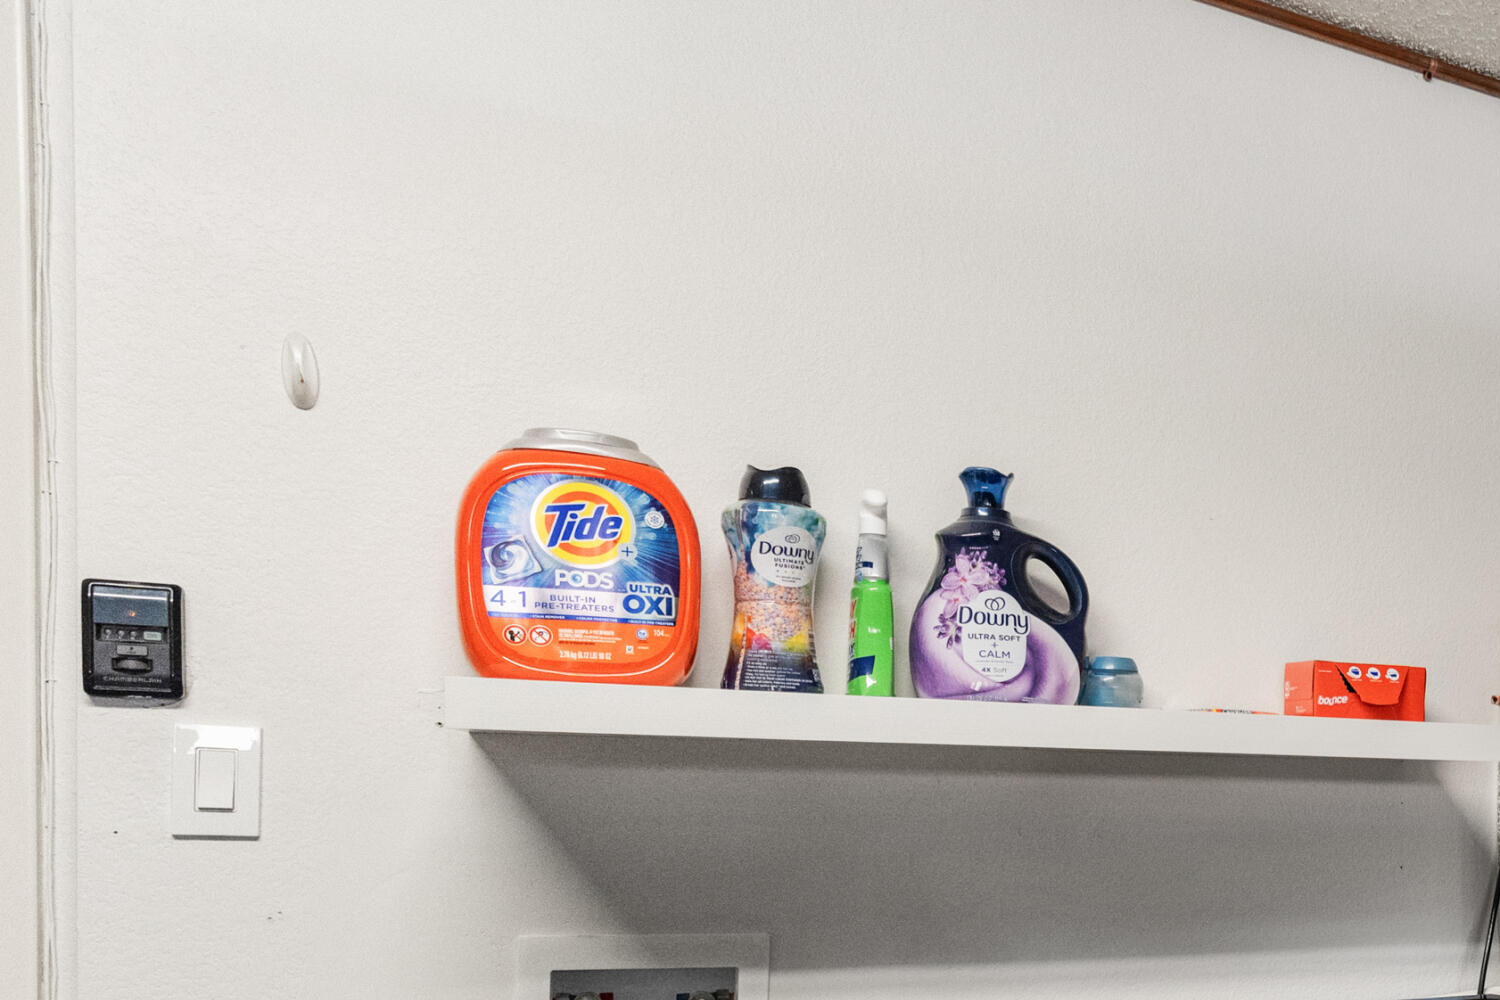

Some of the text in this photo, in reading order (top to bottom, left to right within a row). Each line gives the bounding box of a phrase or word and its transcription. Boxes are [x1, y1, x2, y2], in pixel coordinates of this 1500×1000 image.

[543, 503, 623, 548] Tide
[758, 540, 815, 565] Downy
[774, 557, 805, 566] ULTIMATE
[555, 569, 614, 590] PODS
[629, 583, 672, 596] ULTRA
[549, 594, 597, 604] BUILT-IN
[622, 593, 673, 617] OXI
[534, 601, 615, 613] PRE-TREATERS
[958, 605, 1029, 635] Downy
[967, 632, 1021, 642] ULTRA SOFT
[978, 649, 1011, 659] CALM
[1318, 695, 1349, 706] bounce
